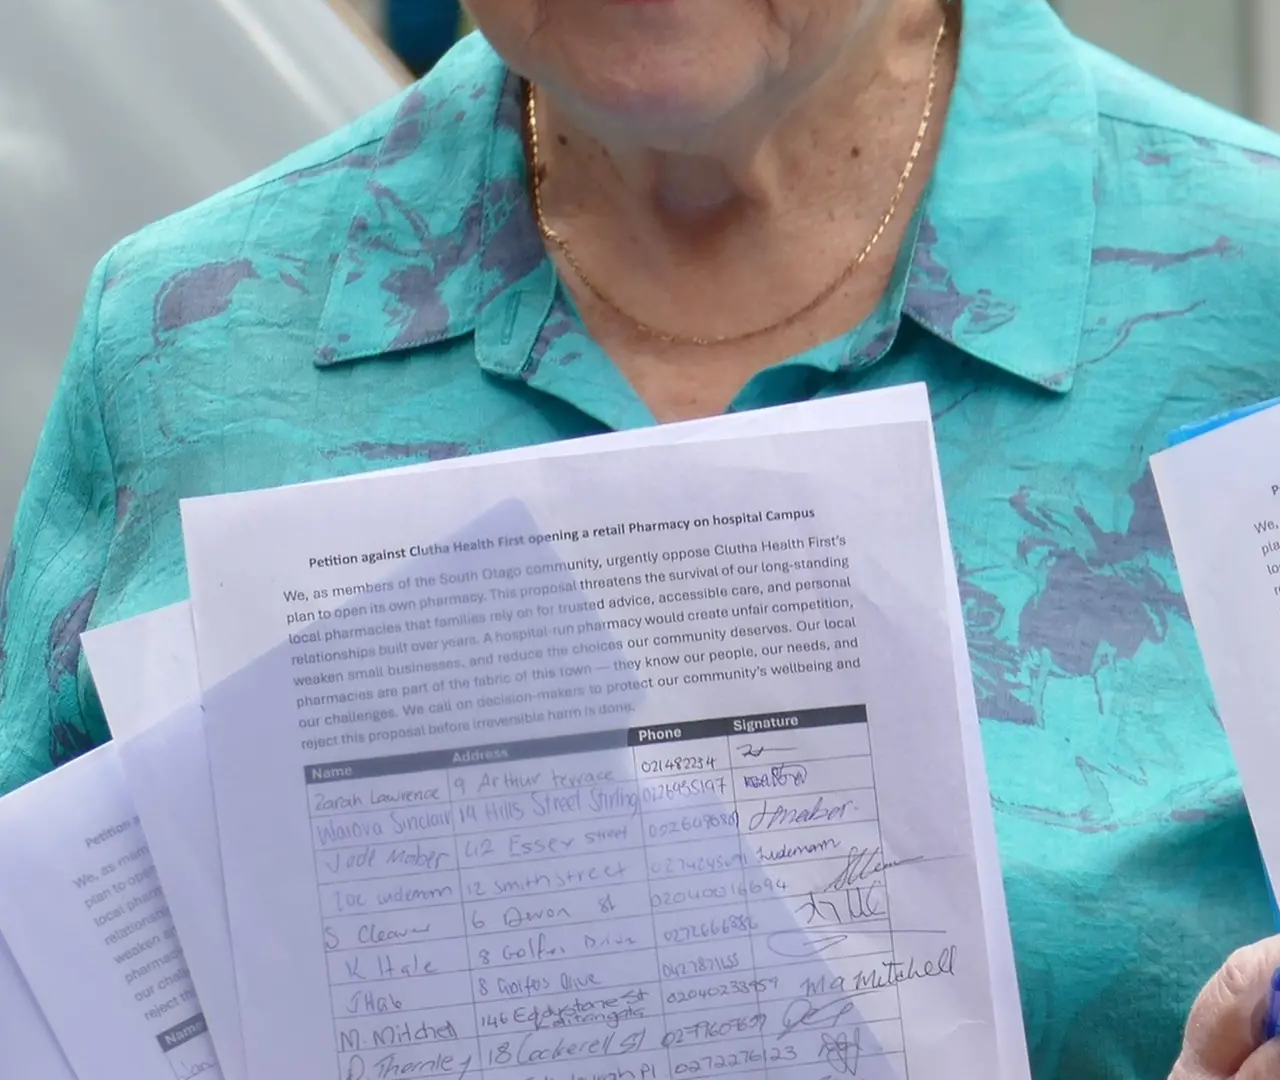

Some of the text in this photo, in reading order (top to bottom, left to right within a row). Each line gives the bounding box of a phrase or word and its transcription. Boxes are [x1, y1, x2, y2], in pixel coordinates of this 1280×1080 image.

[308, 509, 815, 568] Petition against Clutha Health First opening a retail Pharmacy on hospital Campus
[1253, 519, 1279, 534] We,
[282, 534, 846, 602] We, as members of the South Otago community, urgently oppose Clutha Health First's
[312, 715, 799, 780] Name Address Phone Signature
[85, 819, 132, 849] Petition
